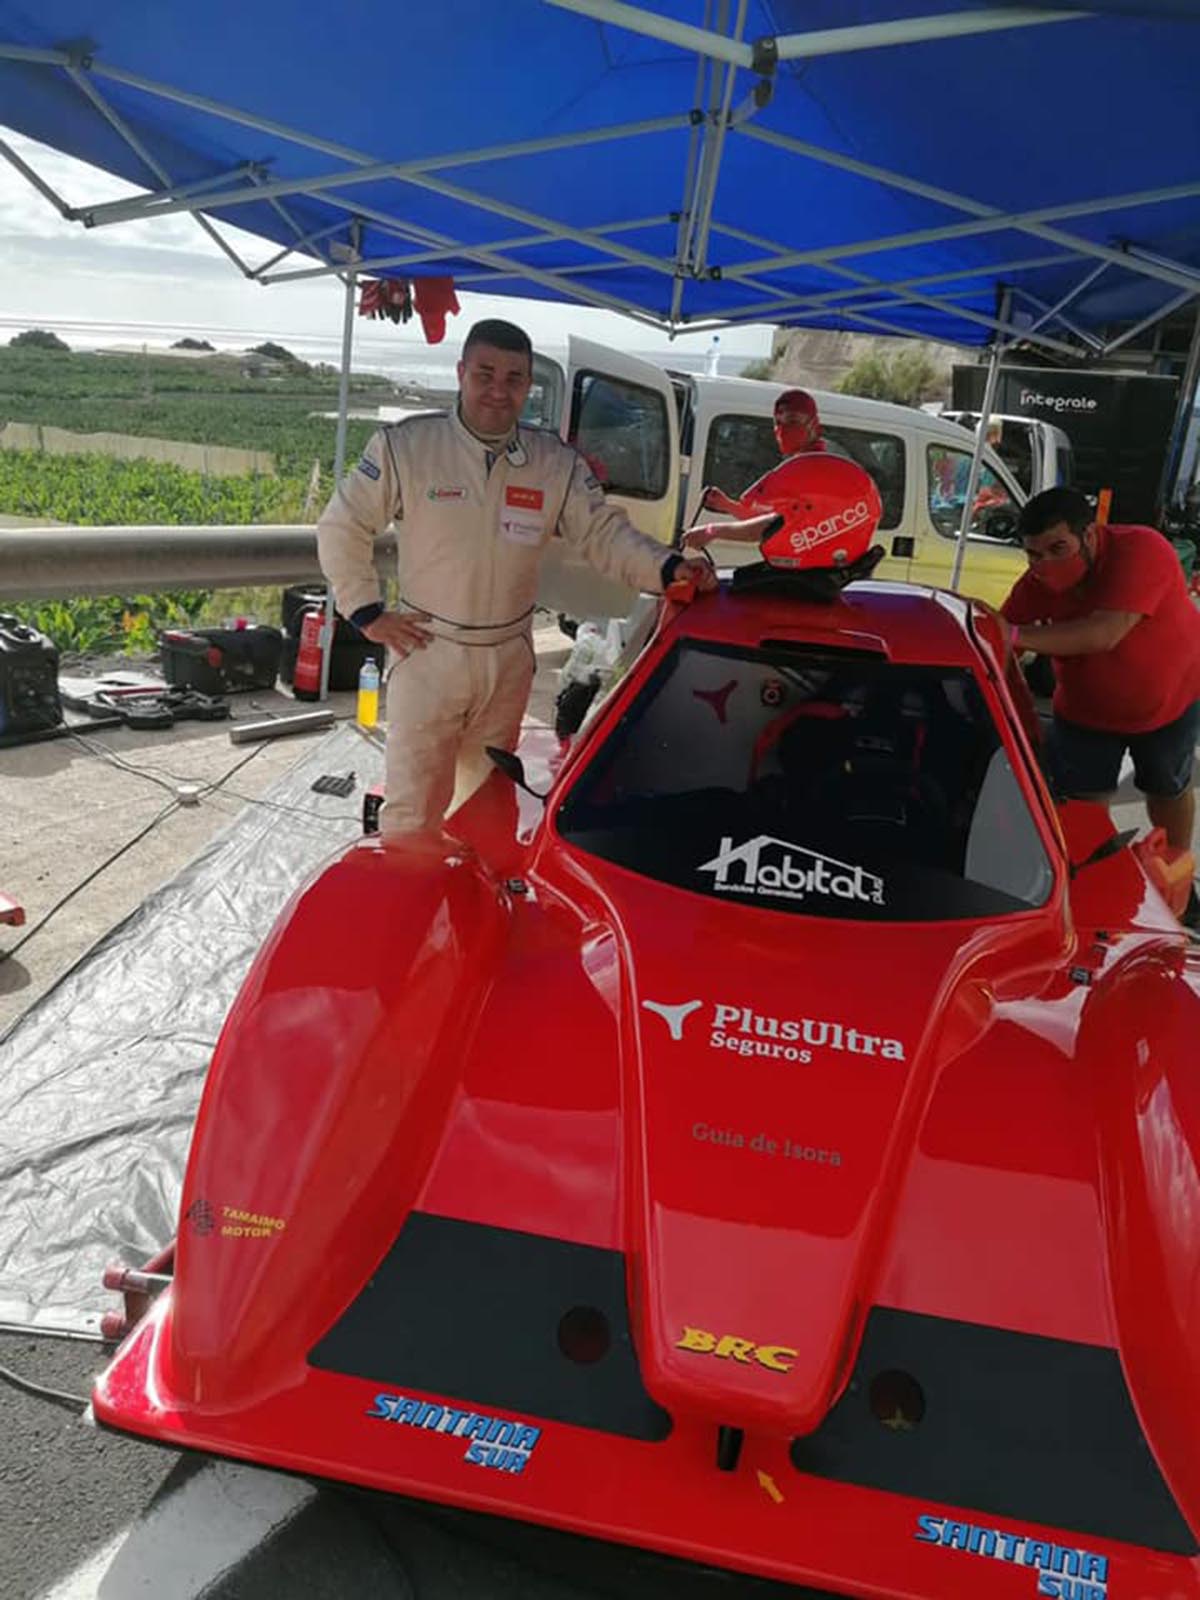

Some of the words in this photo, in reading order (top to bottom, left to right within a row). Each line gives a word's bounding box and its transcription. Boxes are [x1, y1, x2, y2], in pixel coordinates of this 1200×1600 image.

[710, 1031, 813, 1063] Seguros
[711, 1003, 906, 1061] PlusUltra
[750, 1133, 777, 1155] de
[783, 1139, 843, 1167] Isora
[221, 1226, 272, 1237] MOTOR
[223, 1206, 285, 1230] TAMAIMO
[675, 1326, 798, 1373] BRC
[366, 1393, 542, 1450] SANTANA
[464, 1442, 532, 1475] SUR
[914, 1514, 1109, 1583] SANTANA
